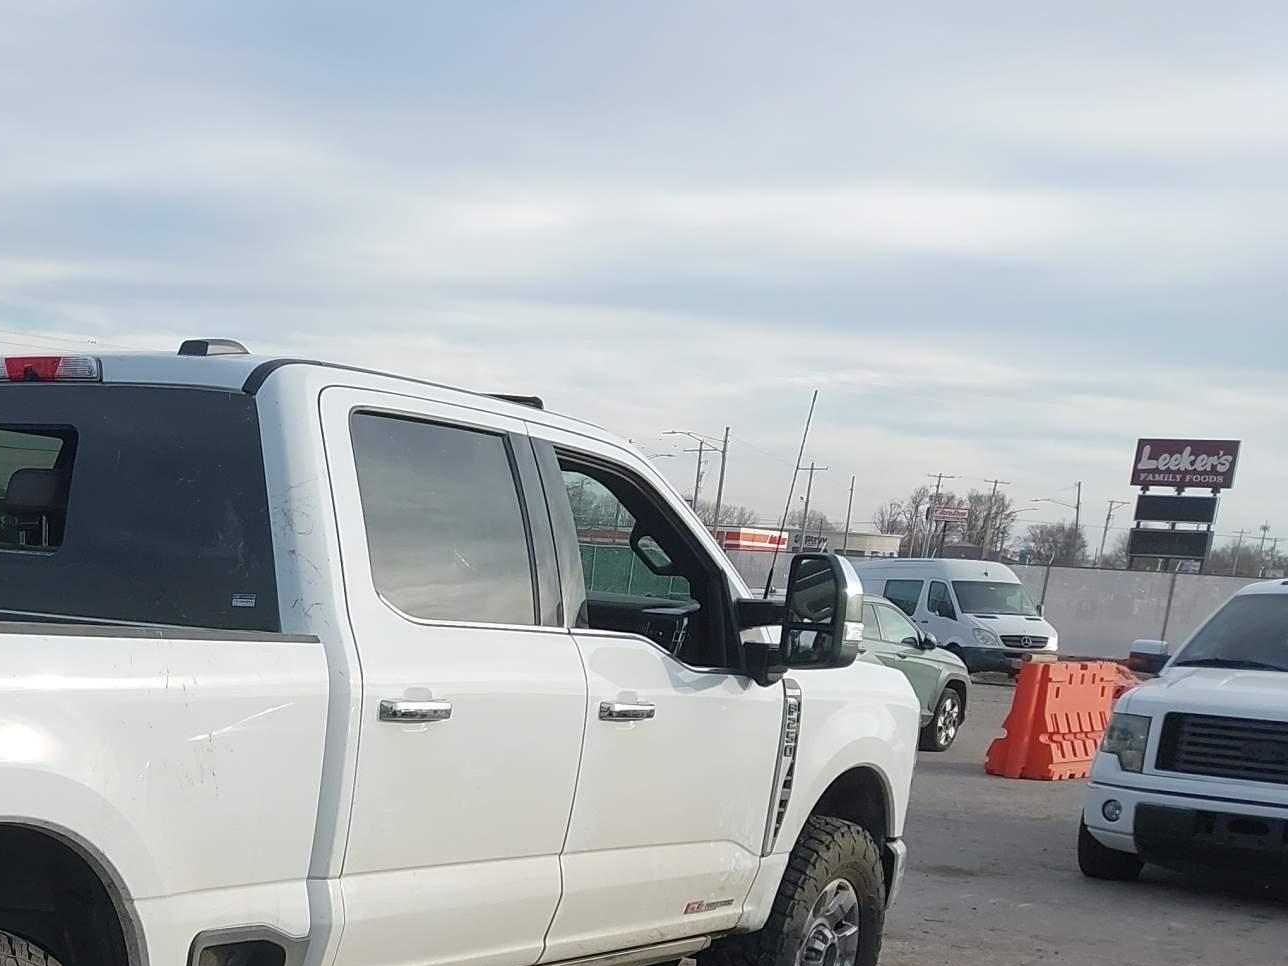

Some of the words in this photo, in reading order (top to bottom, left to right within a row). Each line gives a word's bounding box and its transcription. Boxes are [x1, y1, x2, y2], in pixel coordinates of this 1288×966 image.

[1137, 445, 1232, 472] Leeker's
[1139, 473, 1183, 482] FAMILY
[1185, 474, 1224, 483] FOODS
